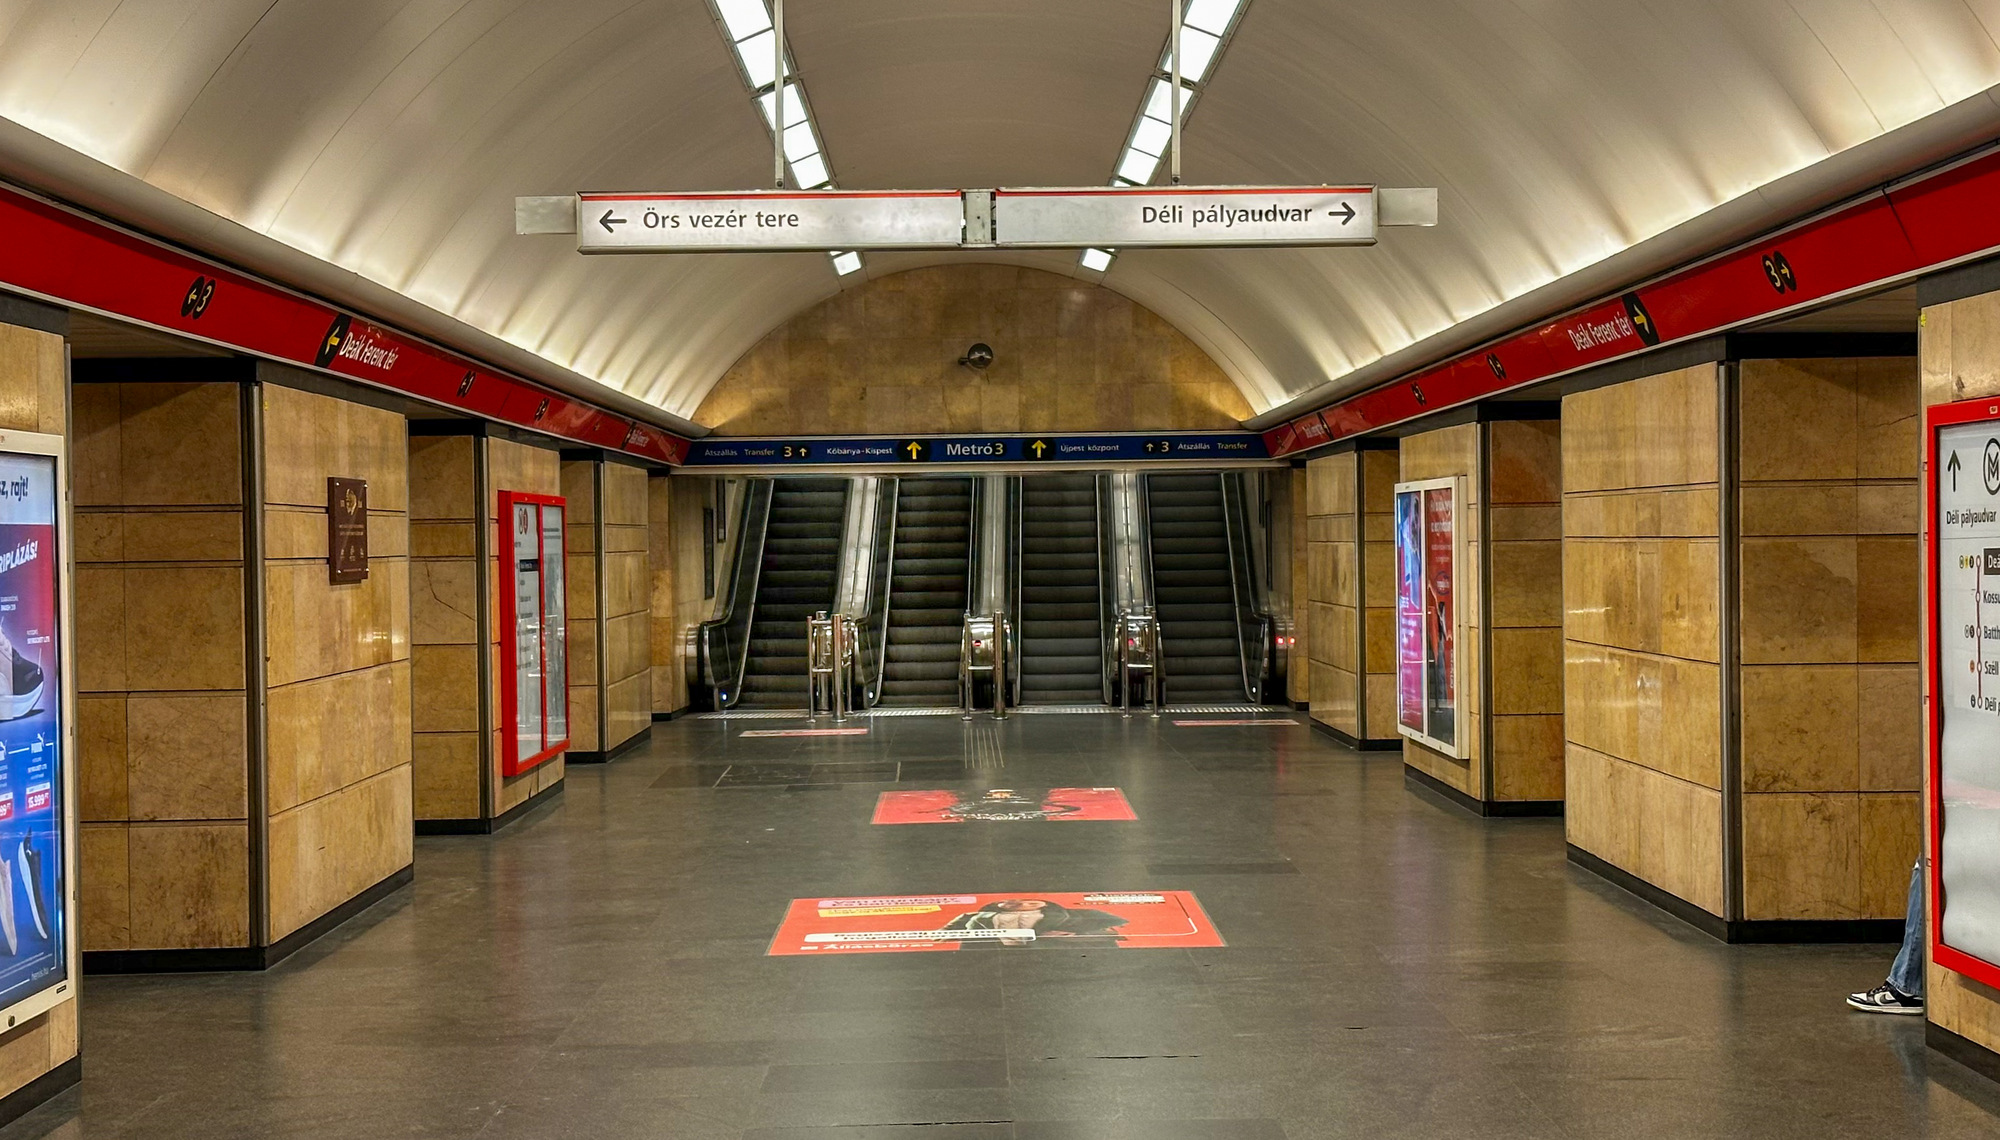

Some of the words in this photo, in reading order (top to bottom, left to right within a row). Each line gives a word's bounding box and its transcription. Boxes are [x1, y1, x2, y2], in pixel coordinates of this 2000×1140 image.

[643, 207, 680, 229] Örs
[689, 209, 747, 229] vezér
[755, 211, 799, 228] tere
[1142, 205, 1183, 224] Déli
[1192, 204, 1313, 227] pályaudvar
[1765, 259, 1782, 287] 3
[1567, 323, 1595, 352] Deák
[1587, 322, 1622, 346] Ferenc
[1613, 311, 1634, 337] tér
[339, 331, 366, 361] Deák
[358, 338, 388, 368] Ferenc
[382, 346, 399, 370] tér
[744, 448, 775, 456] Transfer
[784, 446, 792, 457] 3
[1060, 443, 1085, 453] Újpest
[1087, 443, 1120, 453] központ
[1161, 441, 1169, 452] 3
[1217, 442, 1248, 450] Transfer
[11, 475, 29, 501] rajt!
[1946, 510, 1959, 525] Déli
[1961, 507, 1997, 528] pályaudvar
[1984, 660, 1999, 675] Széll
[1985, 696, 1997, 712] Déli
